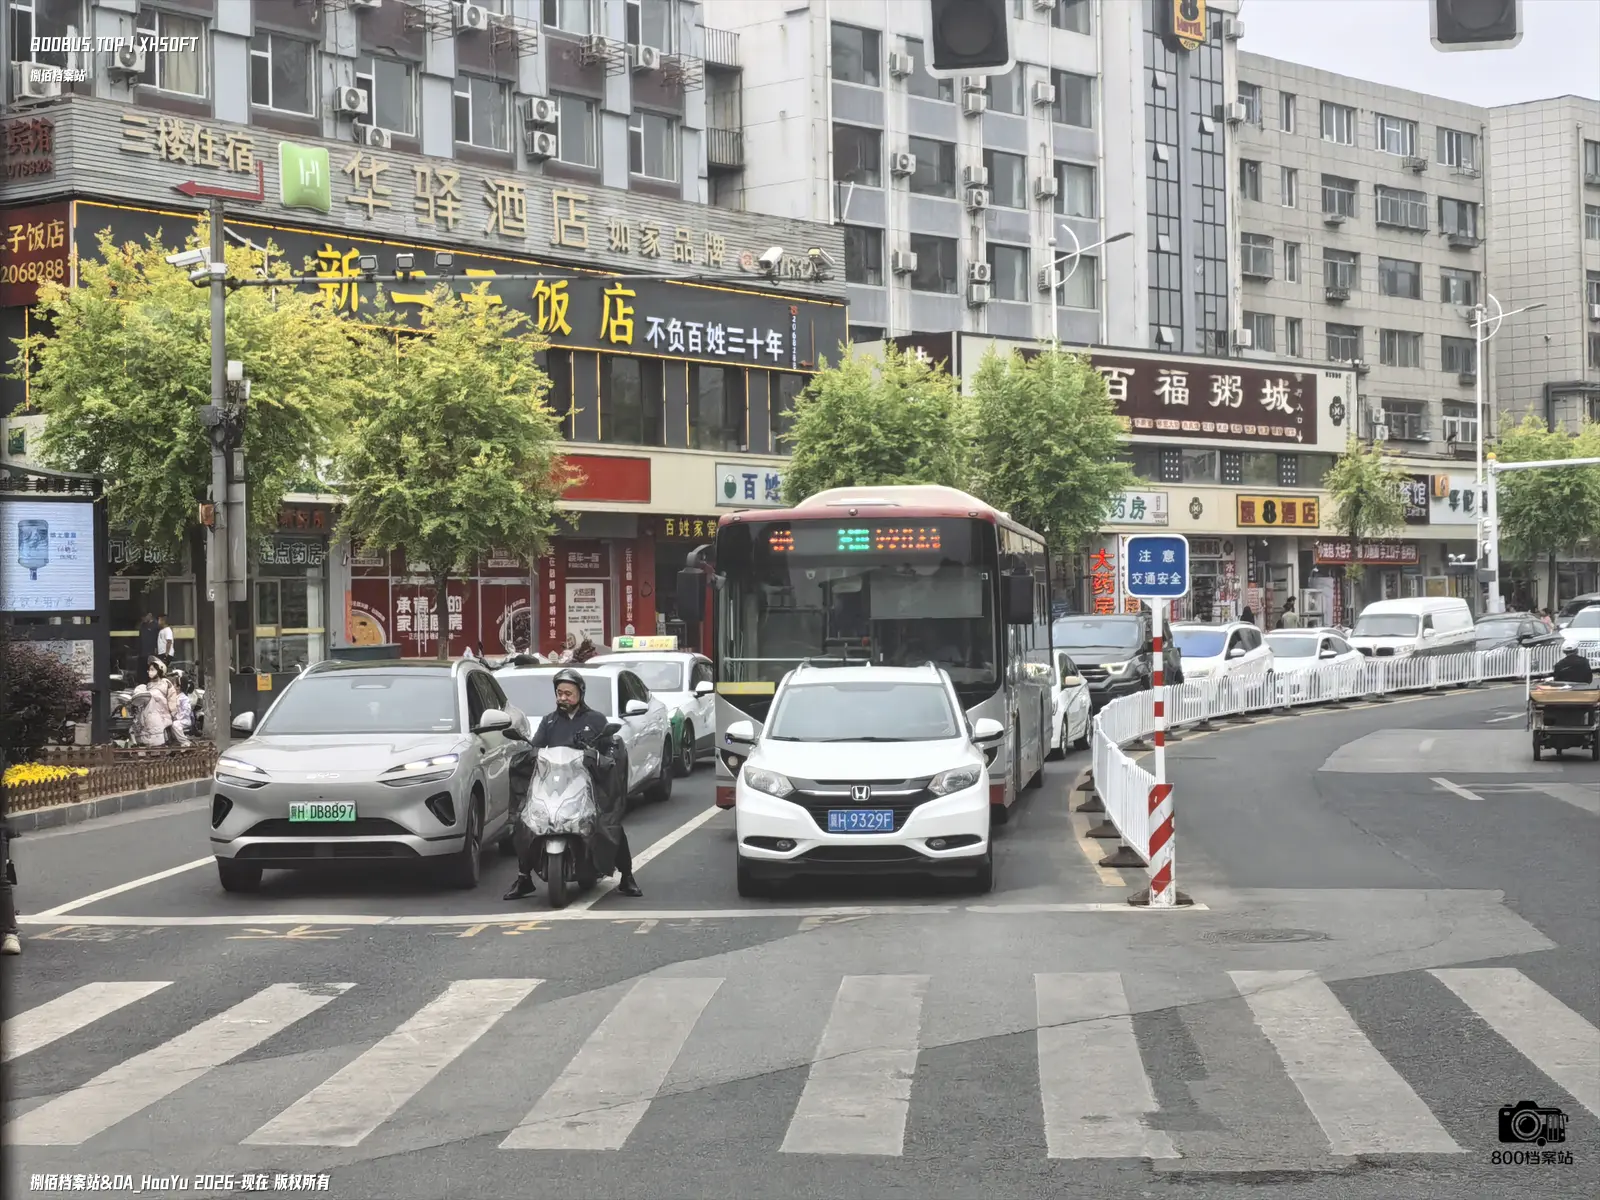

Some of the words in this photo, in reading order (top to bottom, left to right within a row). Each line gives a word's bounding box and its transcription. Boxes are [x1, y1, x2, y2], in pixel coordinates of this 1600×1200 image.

[119, 113, 255, 174] 三楼住宿
[341, 150, 590, 248] 华驿酒店
[607, 214, 726, 268] 如家品牌
[645, 315, 784, 362] 不负百姓三十年
[1096, 364, 1296, 415] 百福粥城
[1090, 548, 1115, 615] 大药房
[1131, 572, 1182, 586] 交通安全
[1138, 549, 1176, 563] 注意
